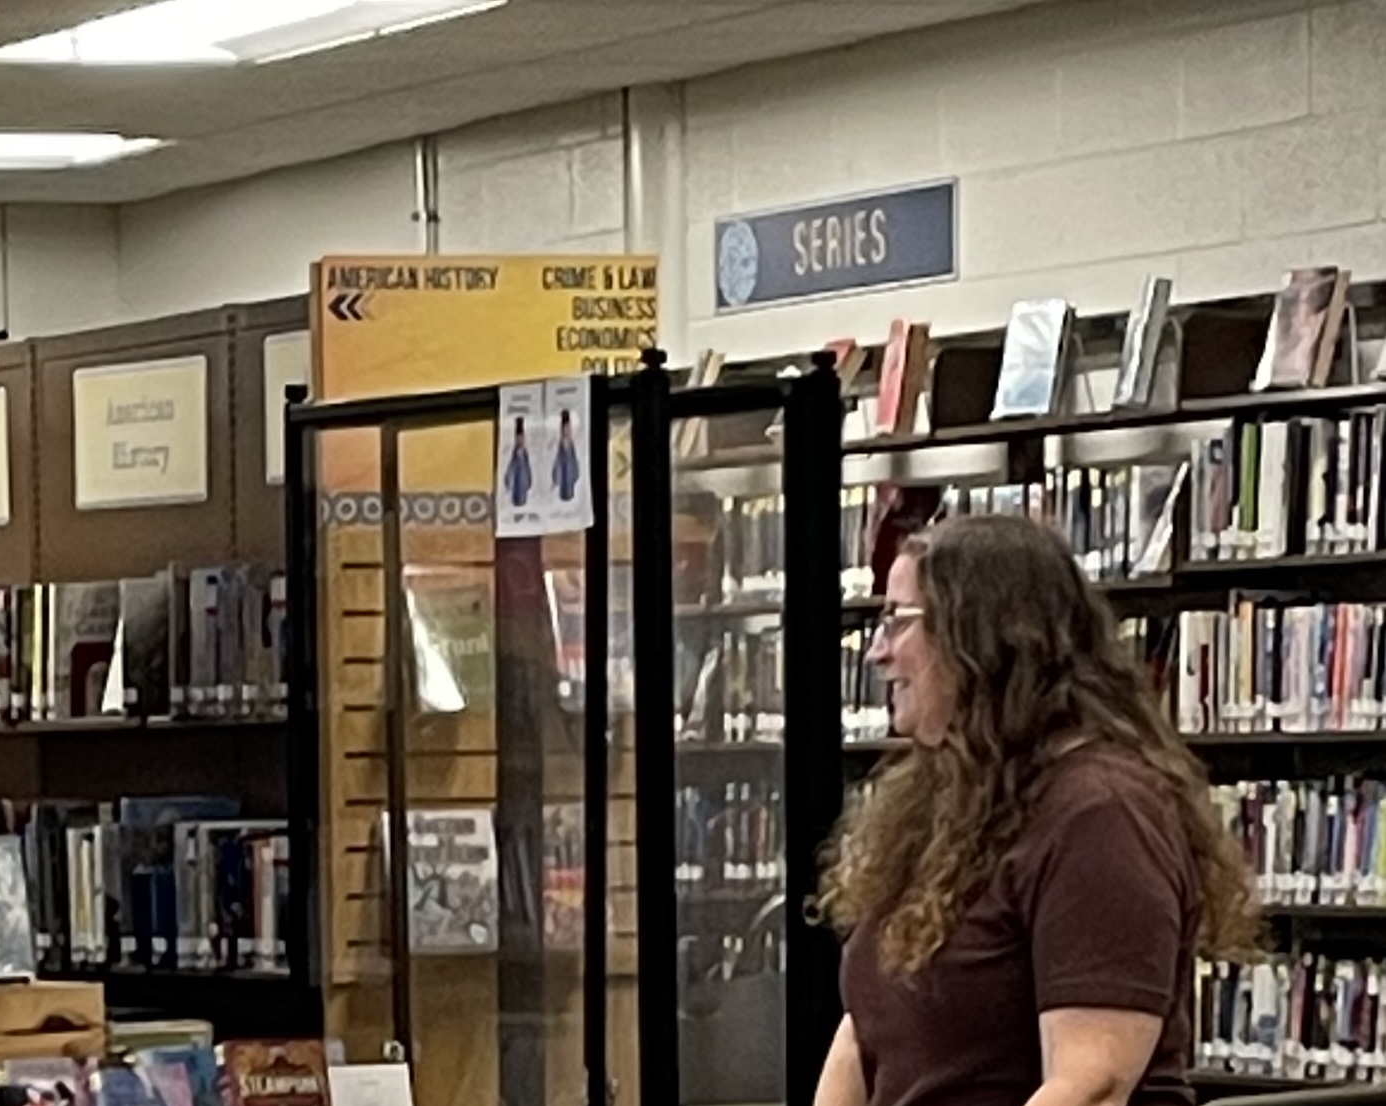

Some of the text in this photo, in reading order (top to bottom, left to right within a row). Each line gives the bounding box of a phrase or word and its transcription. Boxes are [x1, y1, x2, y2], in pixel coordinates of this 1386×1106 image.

[792, 208, 887, 276] SERIES
[327, 267, 498, 290] AMERICAN HISTORY
[542, 266, 596, 290] CRIME
[618, 267, 656, 290] LAW
[572, 296, 656, 320] BUSINESS
[556, 326, 656, 351] ECONOMICS
